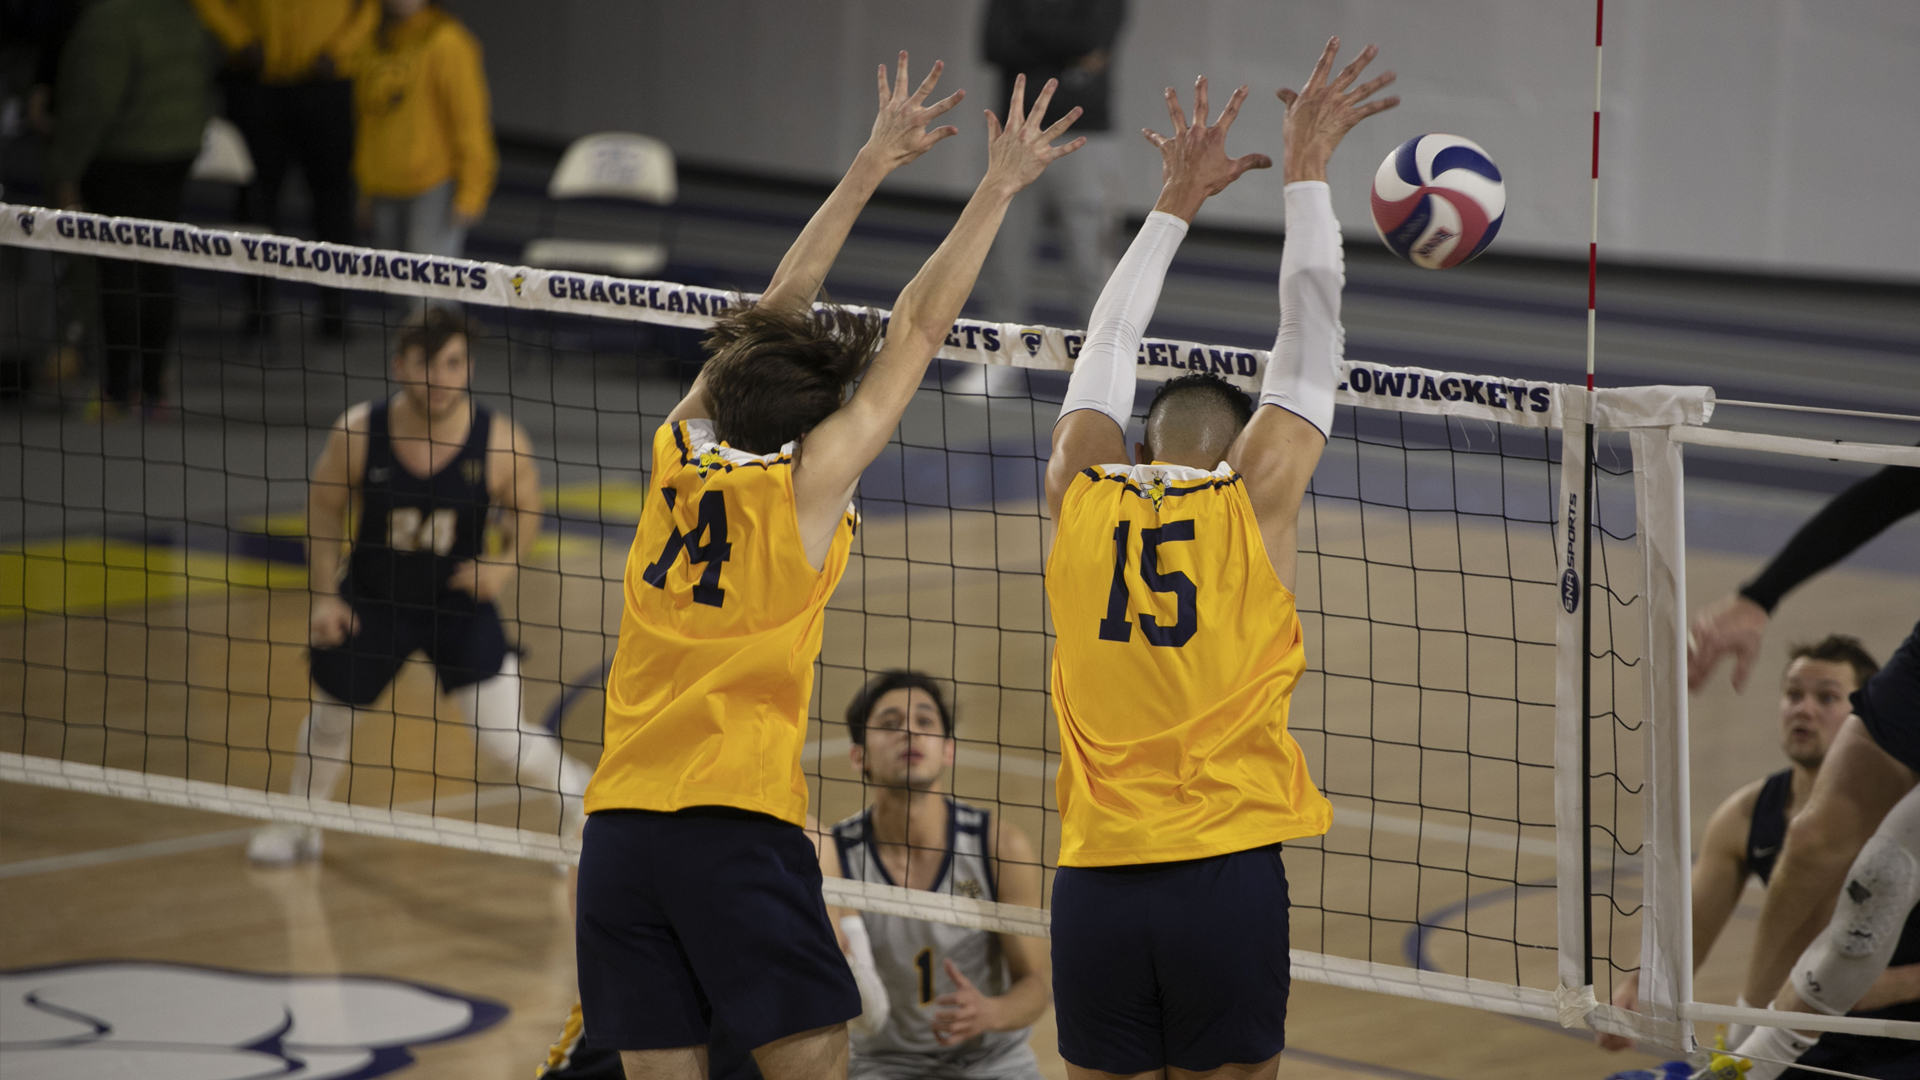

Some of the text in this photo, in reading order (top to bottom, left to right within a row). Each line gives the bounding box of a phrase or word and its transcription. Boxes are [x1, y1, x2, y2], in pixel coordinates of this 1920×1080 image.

[56, 215, 488, 290] GRACELAND YELLOWJACKETS
[548, 275, 729, 317] GRACELAND
[1064, 335, 1258, 377] GELAND
[642, 487, 733, 608] 14
[1566, 493, 1577, 569] SPORTS
[1098, 519, 1198, 647] 15
[914, 947, 934, 1006] 1
